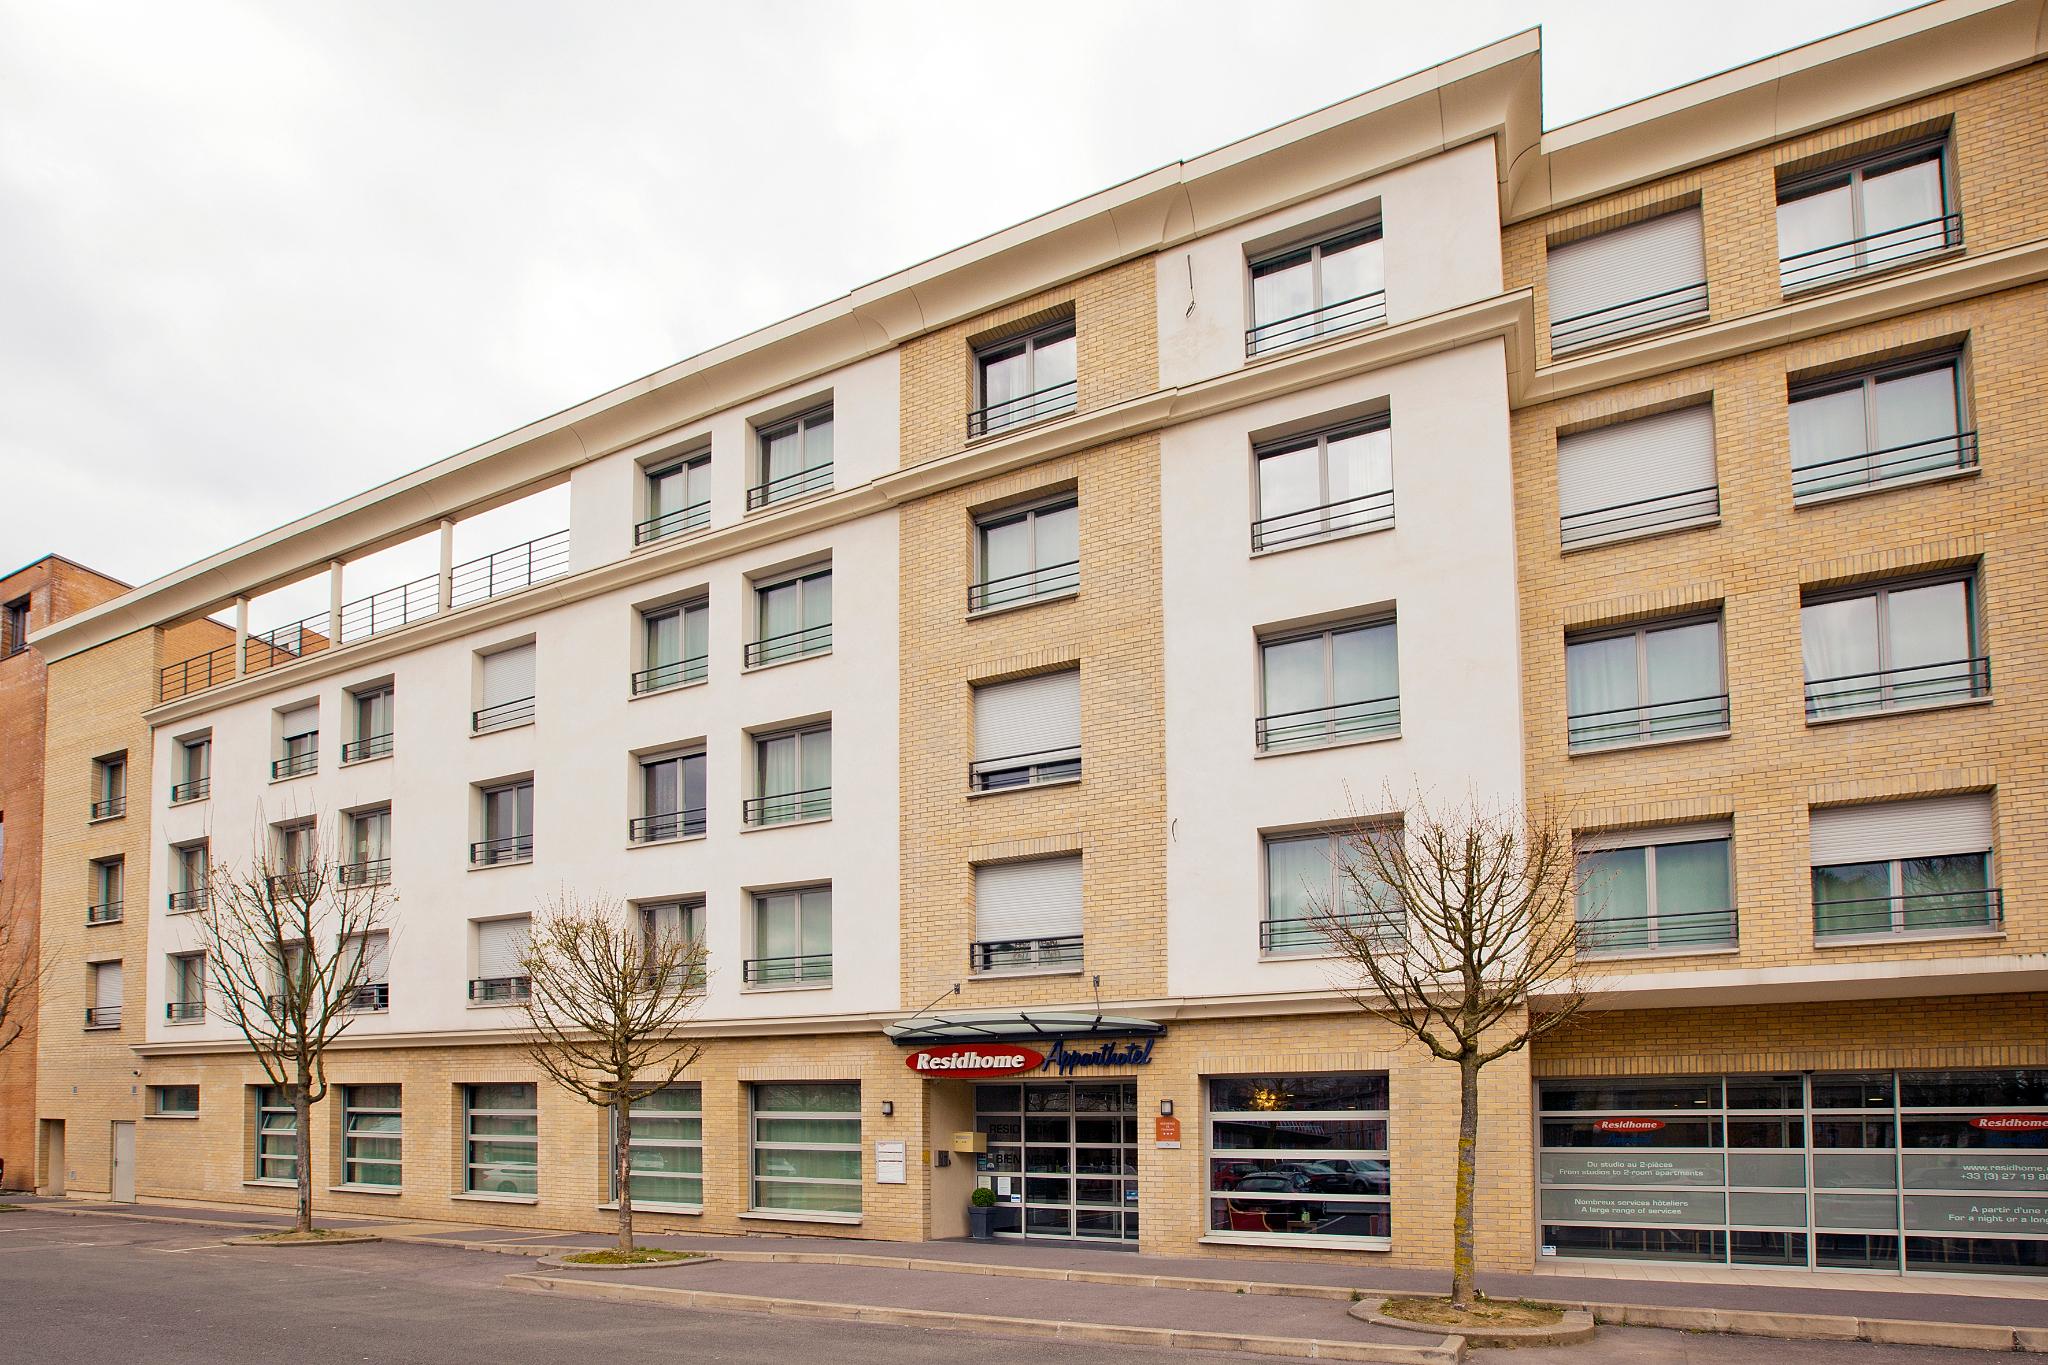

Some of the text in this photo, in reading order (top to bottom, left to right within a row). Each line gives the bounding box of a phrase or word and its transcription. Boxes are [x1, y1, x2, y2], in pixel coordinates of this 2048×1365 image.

[916, 1051, 1025, 1070] Residhome
[1041, 1039, 1155, 1075] Apparthotel
[1601, 1120, 1658, 1130] Residhome
[1623, 1169, 1653, 1177] 2-room
[1655, 1169, 1704, 1177] apartments
[1960, 1172, 1981, 1180] +33
[1574, 1198, 1615, 1206] Nombreux
[1589, 1207, 1610, 1215] large
[1970, 1205, 1979, 1213] A
[1981, 1206, 2011, 1214] partir
[2013, 1206, 2041, 1214] d'une
[1948, 1213, 1966, 1221] For
[1977, 1215, 2003, 1224] night
